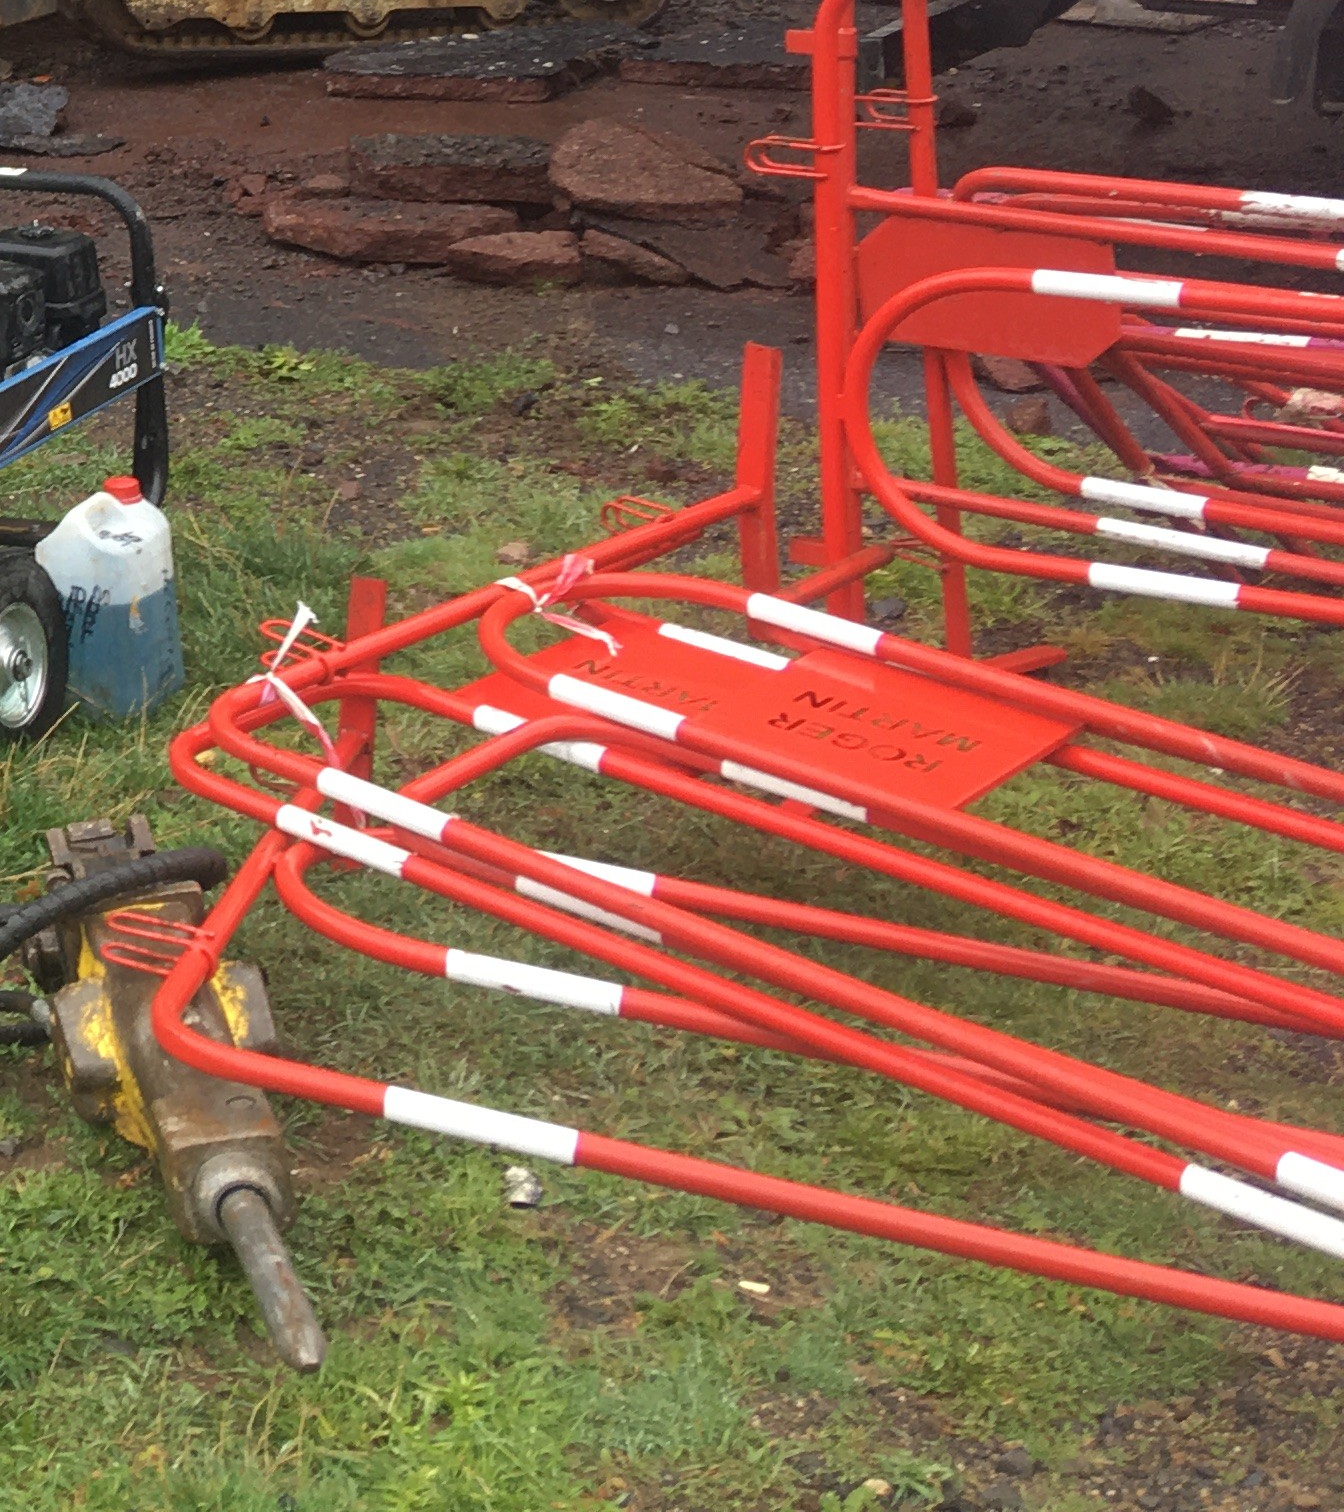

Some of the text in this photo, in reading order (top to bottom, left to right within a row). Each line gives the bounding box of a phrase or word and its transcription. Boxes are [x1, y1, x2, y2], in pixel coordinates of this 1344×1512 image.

[109, 363, 138, 389] 4000
[114, 339, 137, 369] HX
[768, 711, 944, 774] ROGER
[794, 689, 982, 753] MARTIN
